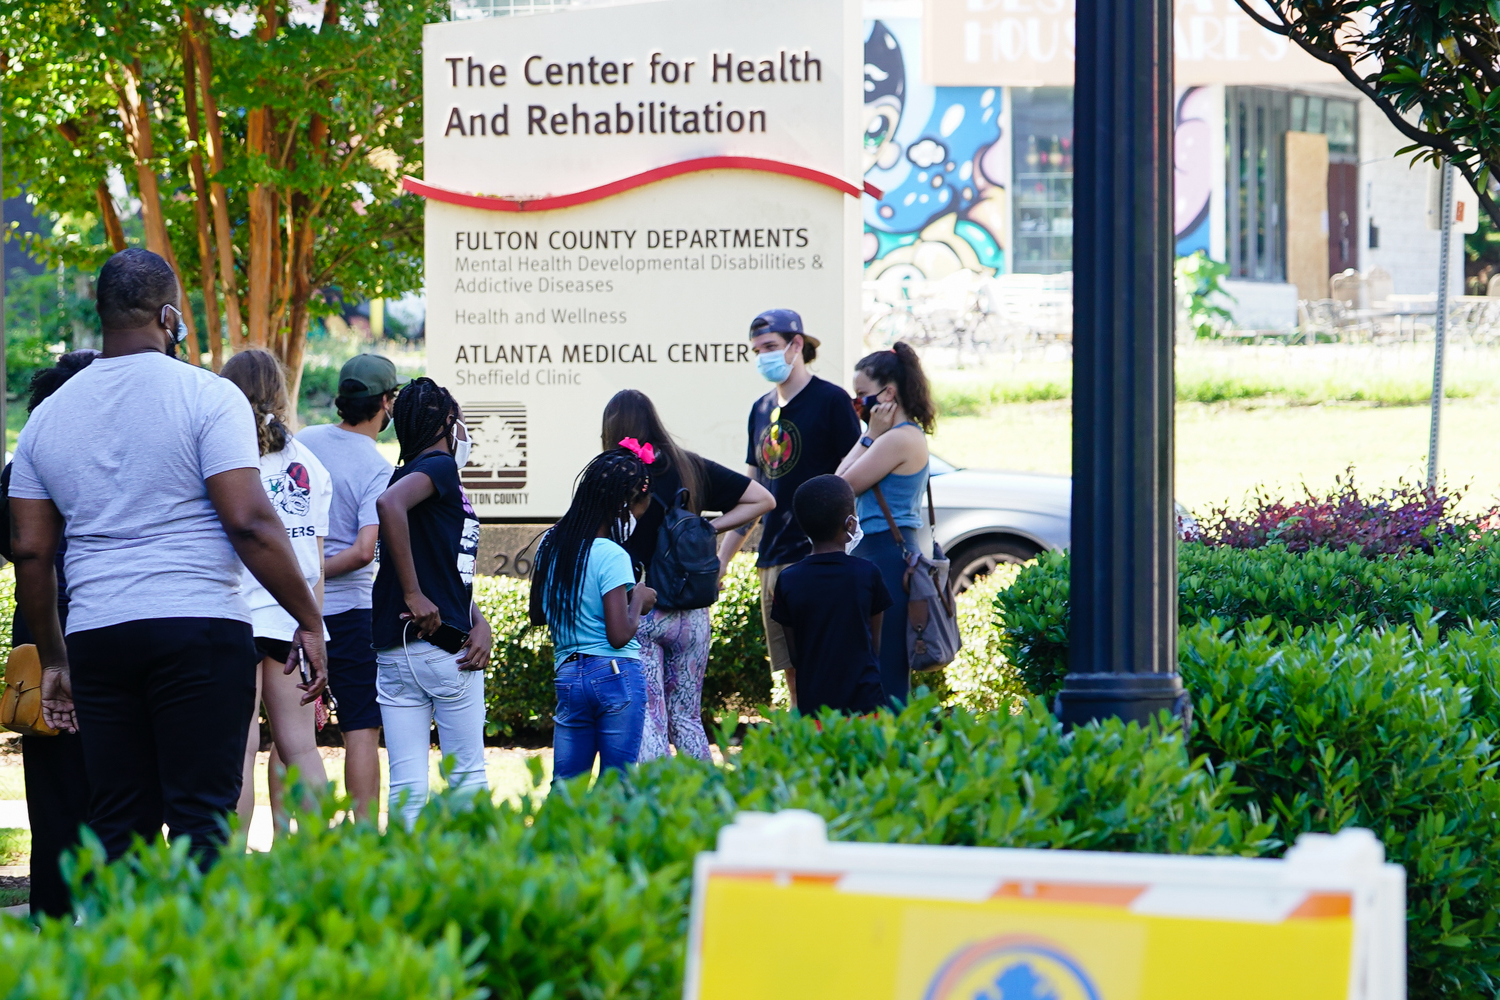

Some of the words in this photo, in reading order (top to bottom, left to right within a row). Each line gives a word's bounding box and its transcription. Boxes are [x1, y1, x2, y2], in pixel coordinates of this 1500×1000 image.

[444, 55, 507, 88] The
[523, 54, 634, 87] Center
[649, 52, 696, 85] for
[712, 50, 822, 84] Health
[444, 103, 510, 137] And
[527, 100, 767, 136] Rehabilitation
[455, 230, 538, 251] FULTON
[548, 229, 637, 251] COUNTY
[647, 227, 809, 249] DEPARTMENTS
[454, 255, 513, 273] Mental
[518, 255, 572, 273] Health
[577, 253, 705, 275] Developmental
[710, 252, 806, 271] Disabilities
[811, 253, 824, 270] &
[454, 276, 533, 294] Addictive
[538, 276, 614, 294] Diseases
[455, 308, 509, 325] Health
[514, 307, 546, 325] and
[550, 307, 628, 325] Wellness
[455, 344, 553, 364] ATLANTA
[562, 343, 658, 364] MEDICAL
[667, 343, 749, 363] CENTER
[455, 368, 530, 386] Sheffield
[535, 368, 582, 386] Clinic
[493, 492, 530, 505] COUNTY
